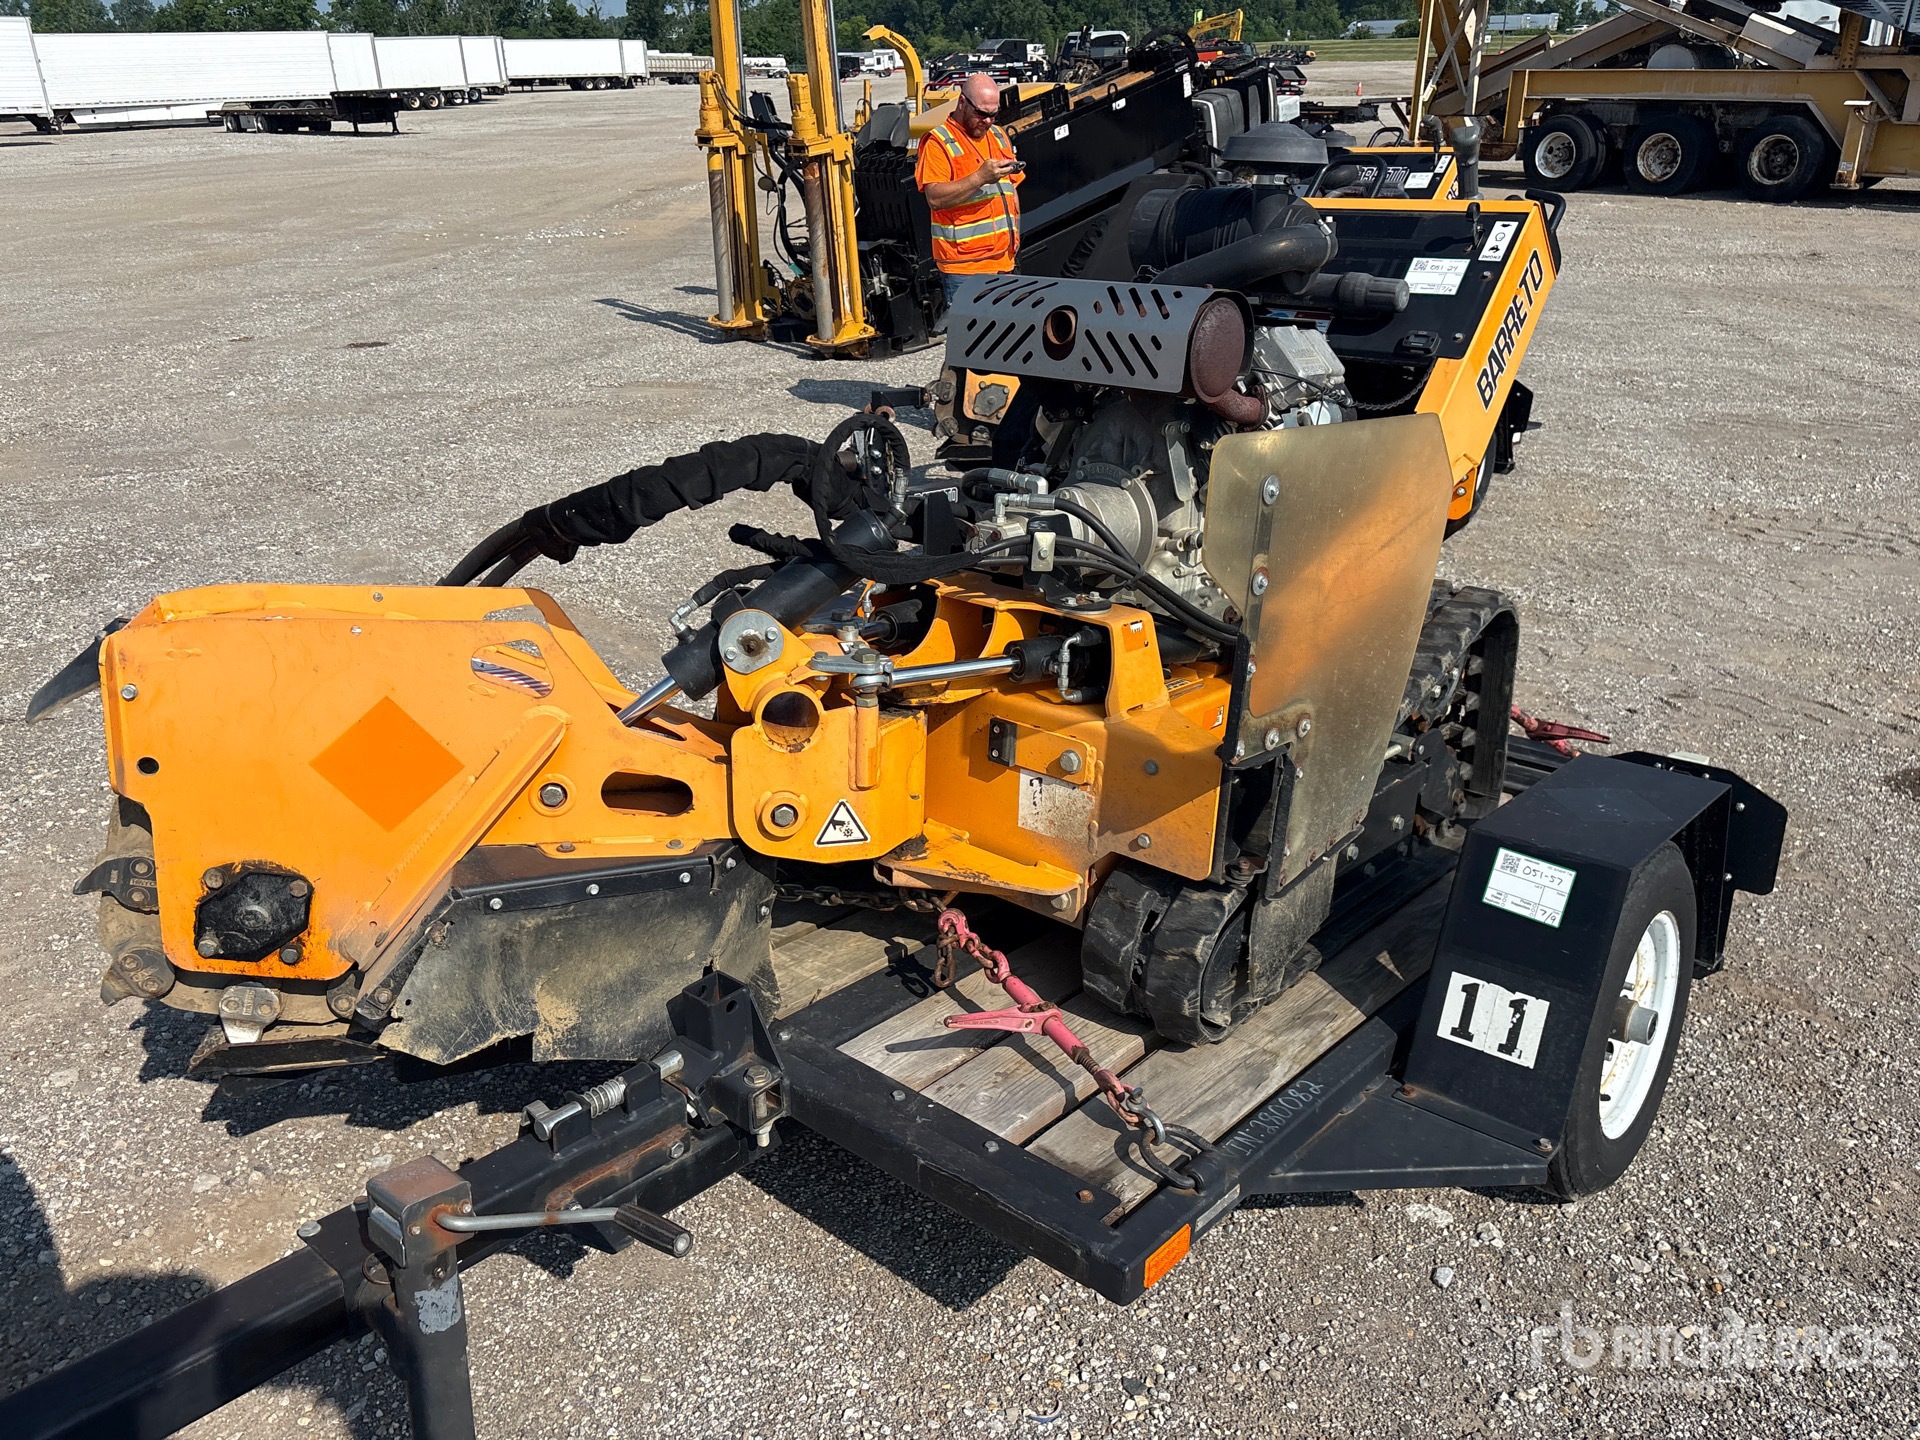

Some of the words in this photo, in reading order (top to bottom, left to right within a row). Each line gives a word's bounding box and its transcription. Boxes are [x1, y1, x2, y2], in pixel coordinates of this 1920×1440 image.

[1476, 248, 1544, 412] BARRETO
[1522, 865, 1563, 886] 051-57
[1540, 908, 1557, 924] 7/9
